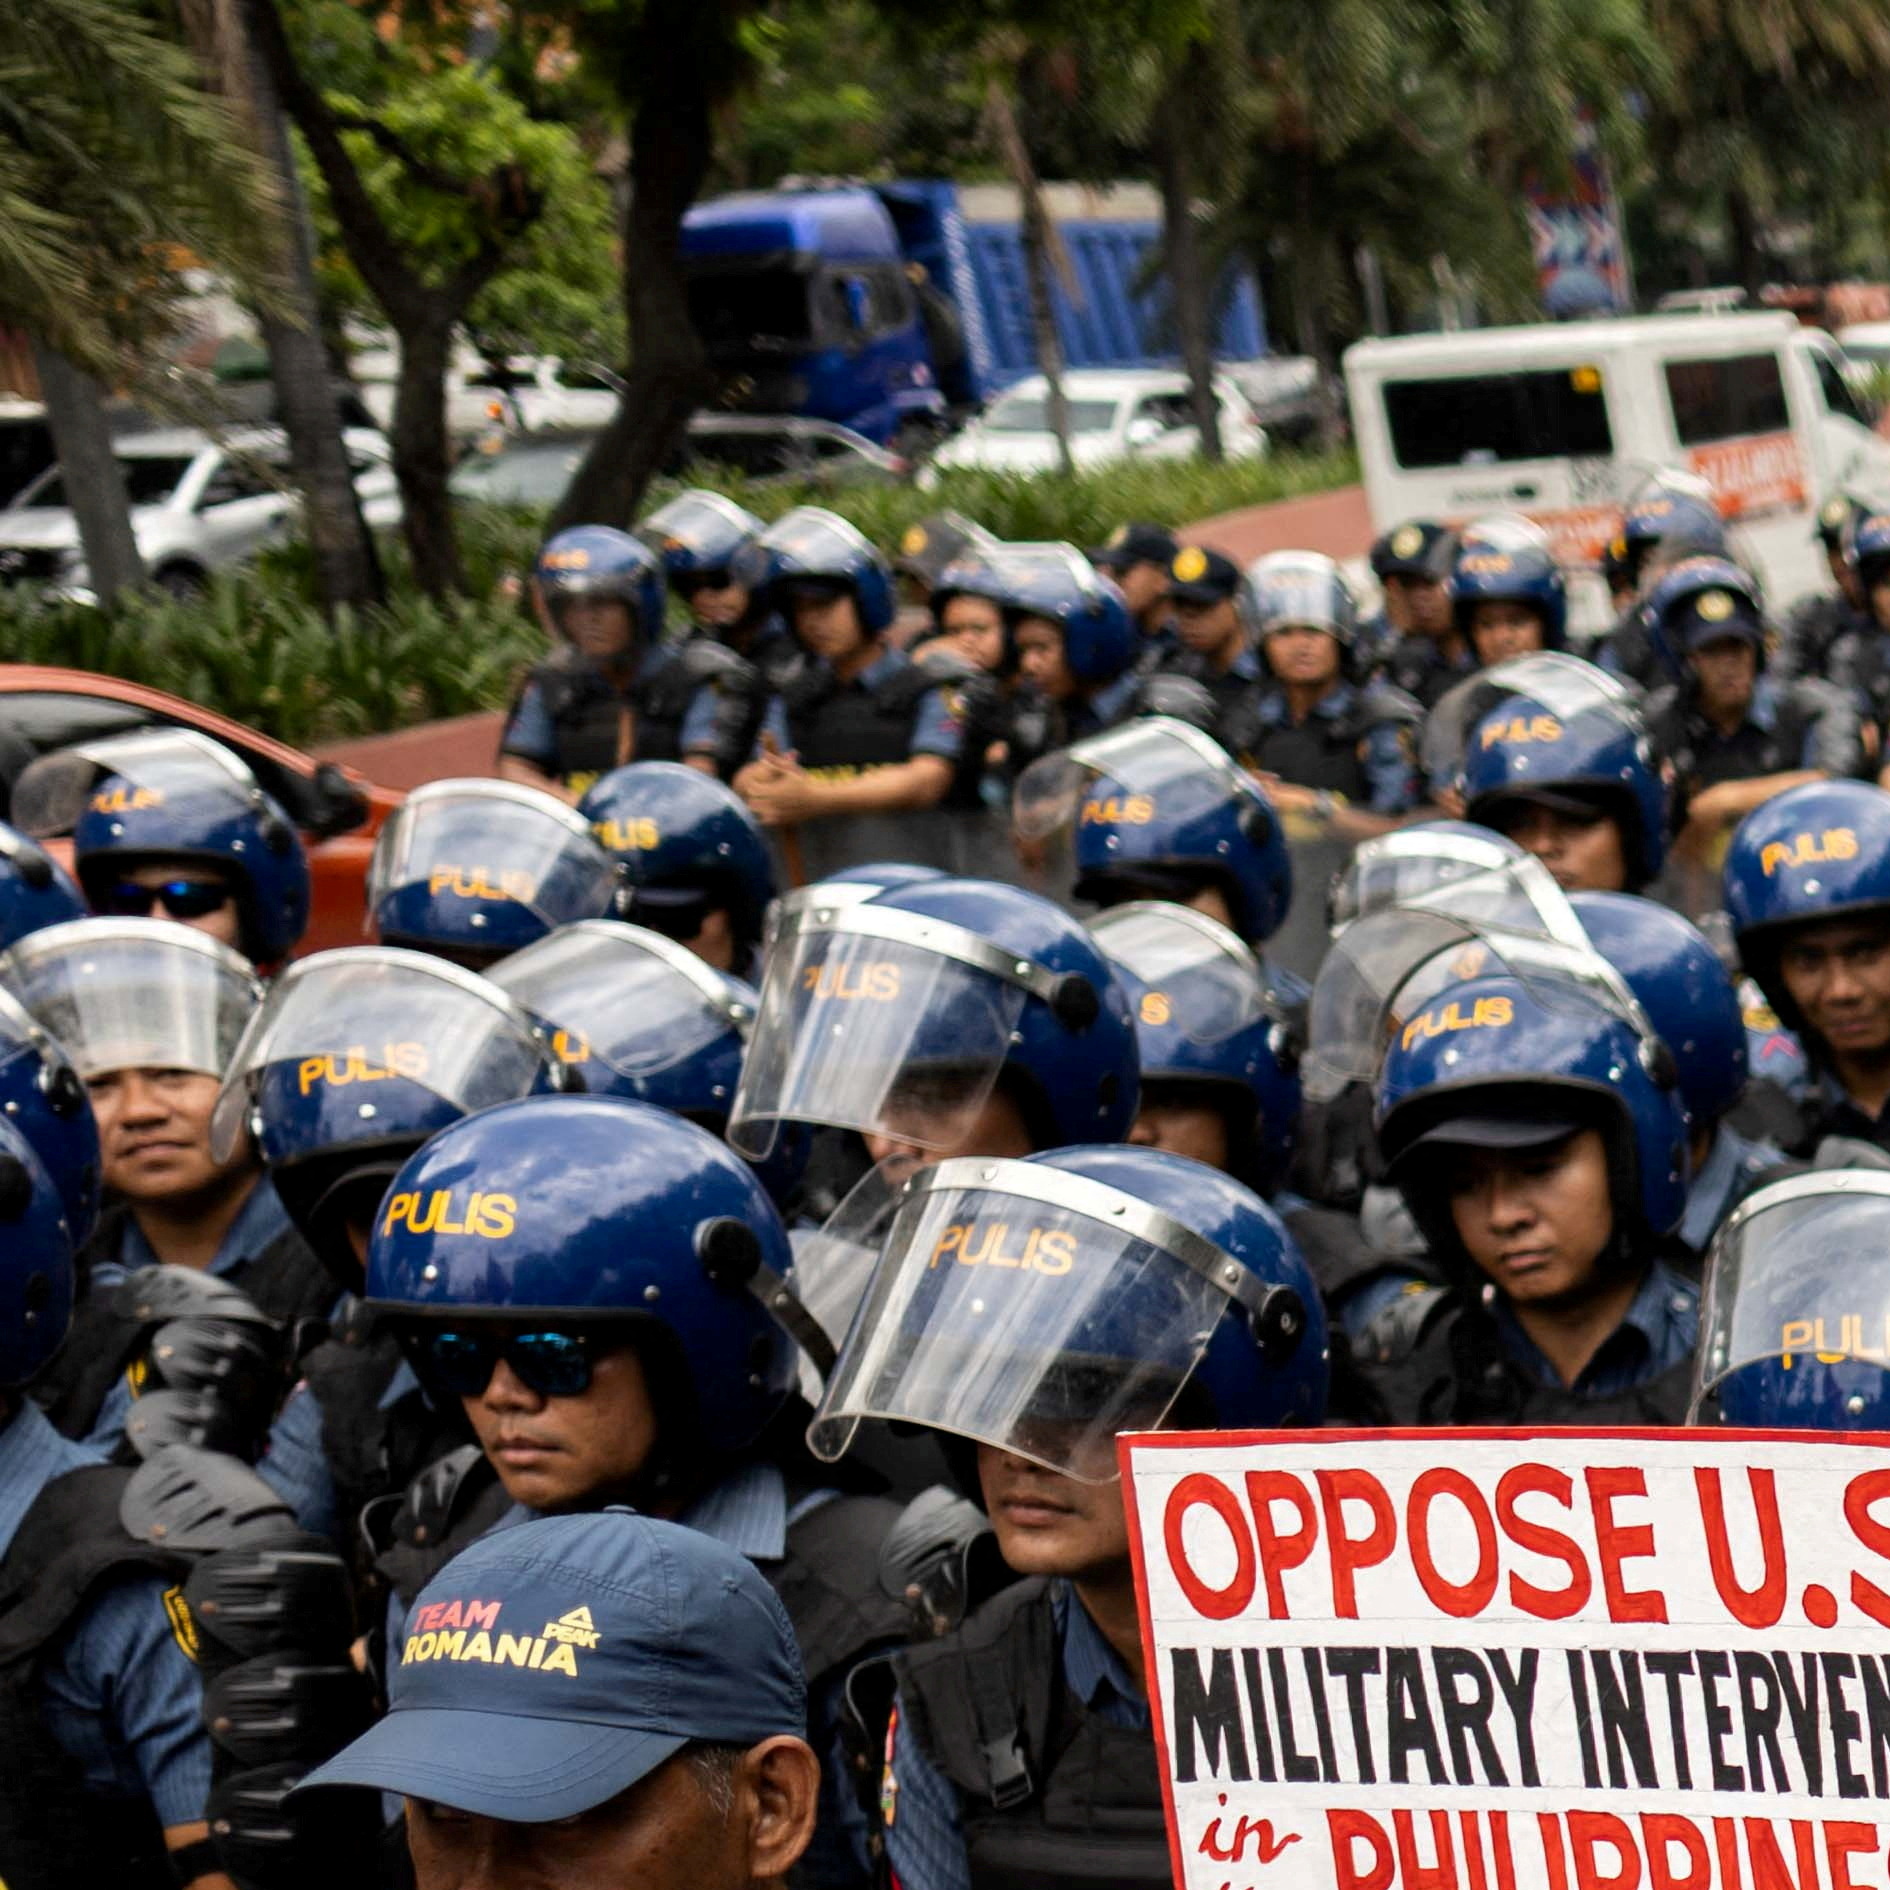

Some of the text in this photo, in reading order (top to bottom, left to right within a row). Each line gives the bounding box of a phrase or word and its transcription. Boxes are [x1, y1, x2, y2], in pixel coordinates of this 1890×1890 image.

[1401, 997, 1513, 1051] PULIS
[301, 1041, 428, 1096] PULIS
[384, 1193, 517, 1239] PULIS
[929, 1225, 1077, 1275] PULIS
[1164, 1463, 1669, 1625] OPPOSE
[413, 1599, 502, 1632] TEAM
[542, 1622, 602, 1649] PEAK
[401, 1630, 578, 1678] ROMANIA
[1170, 1645, 1546, 1788] MILITARY
[1198, 1792, 1301, 1867] in
